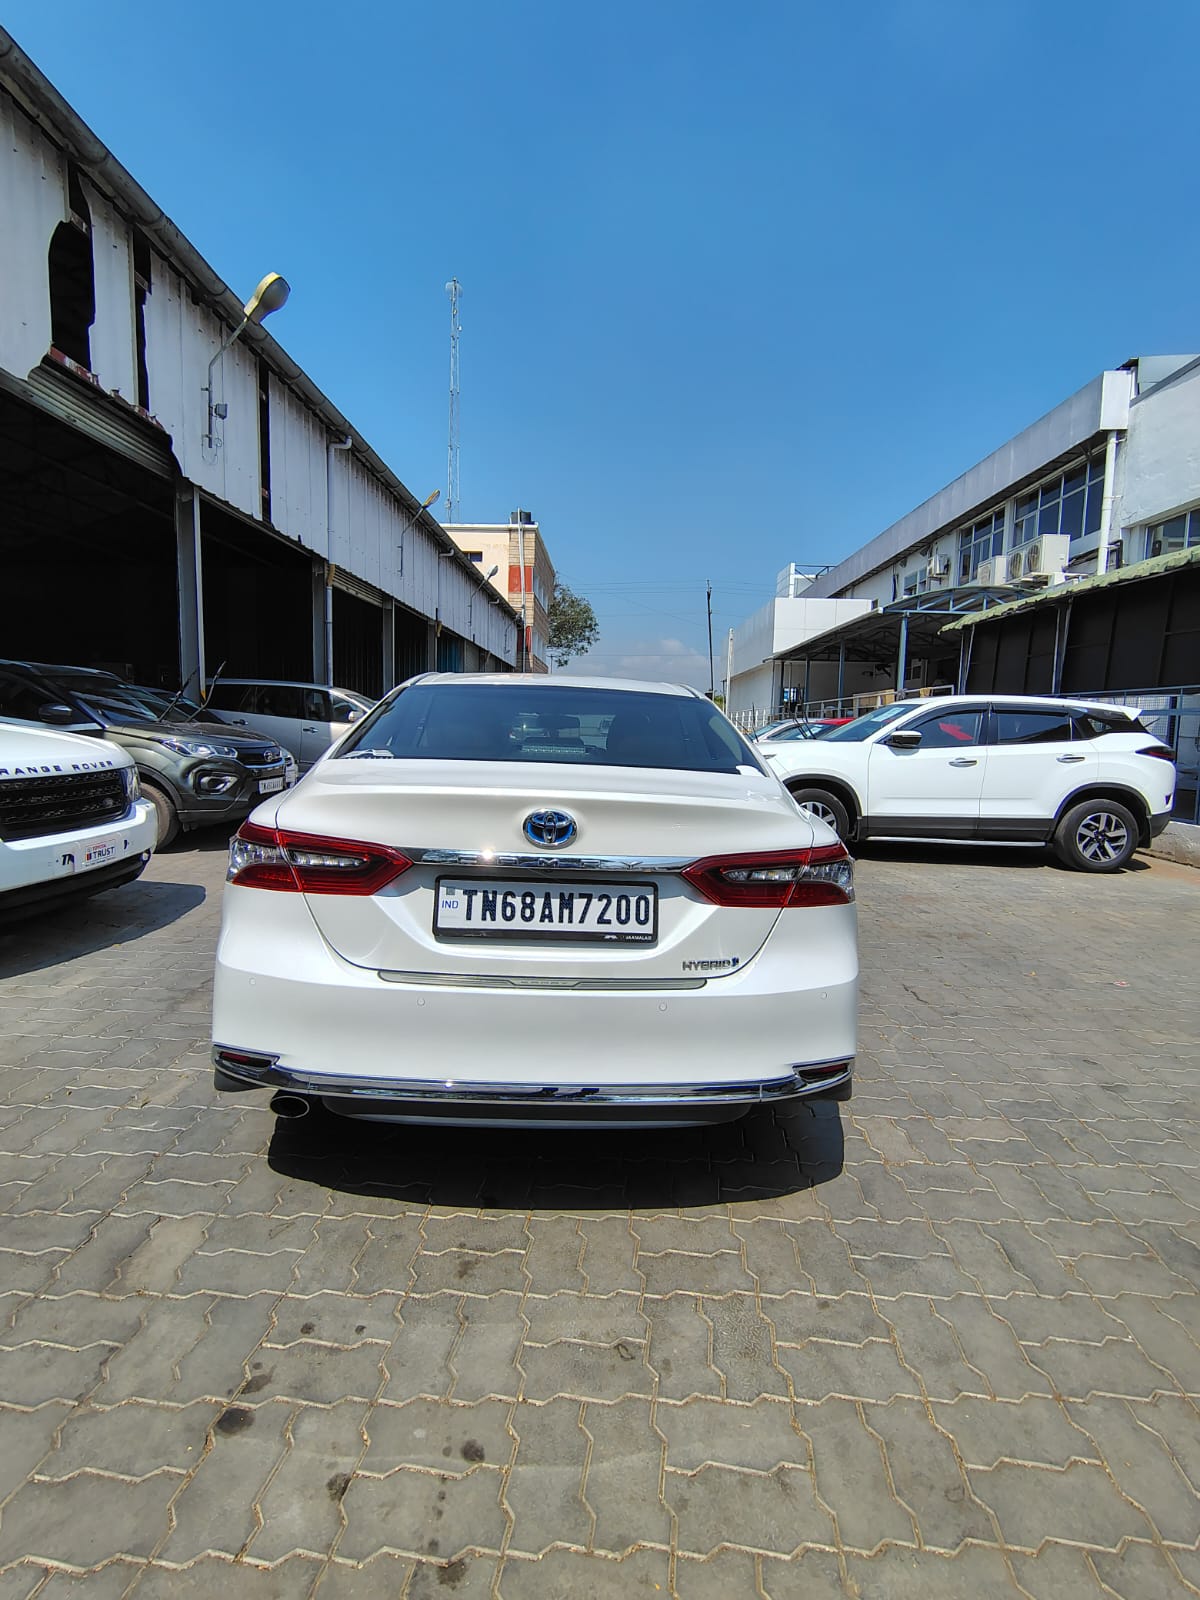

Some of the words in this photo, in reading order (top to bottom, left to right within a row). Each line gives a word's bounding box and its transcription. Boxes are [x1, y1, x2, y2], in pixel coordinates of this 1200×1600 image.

[0, 765, 62, 775] RANGE
[72, 760, 113, 771] ROVER
[93, 846, 115, 859] TRUST
[441, 900, 459, 909] IND
[463, 889, 650, 926] TN68AM7200
[682, 959, 731, 971] HYBRID
